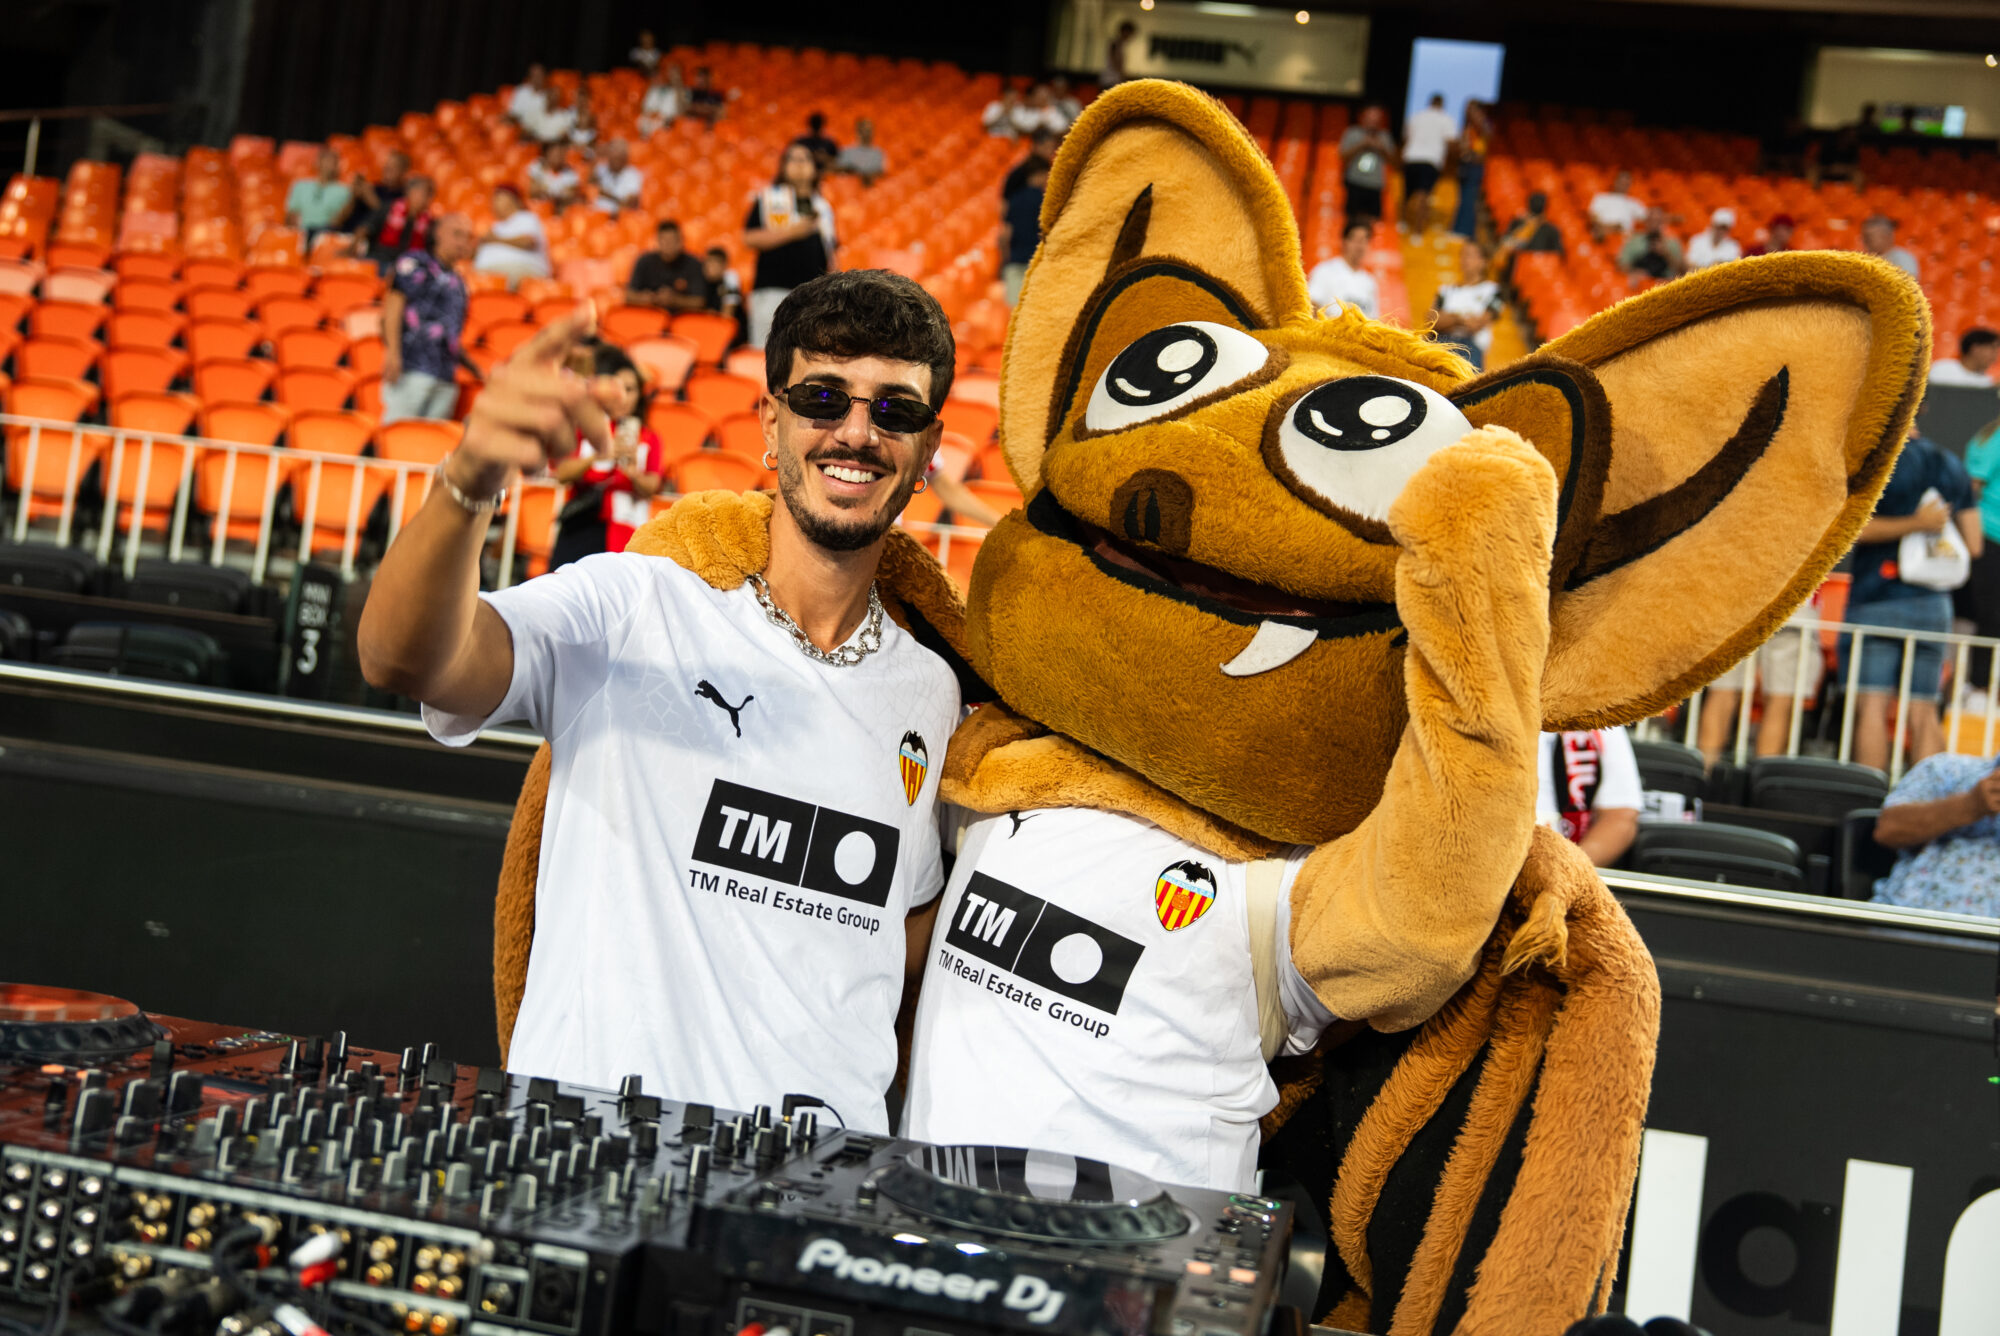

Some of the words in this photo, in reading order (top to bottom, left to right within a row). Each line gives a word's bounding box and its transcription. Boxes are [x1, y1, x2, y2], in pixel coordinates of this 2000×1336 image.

[296, 628, 321, 674] 3
[719, 804, 793, 865] TM
[688, 868, 720, 893] TM
[724, 878, 769, 905] Real
[772, 890, 833, 921] Estate
[836, 906, 881, 936] Group
[958, 892, 1018, 948] TM
[938, 949, 955, 971] TM
[953, 957, 985, 986] Real
[986, 973, 1043, 1012] Estate
[1047, 1001, 1111, 1039] Group
[796, 1237, 1000, 1304] Pioneer
